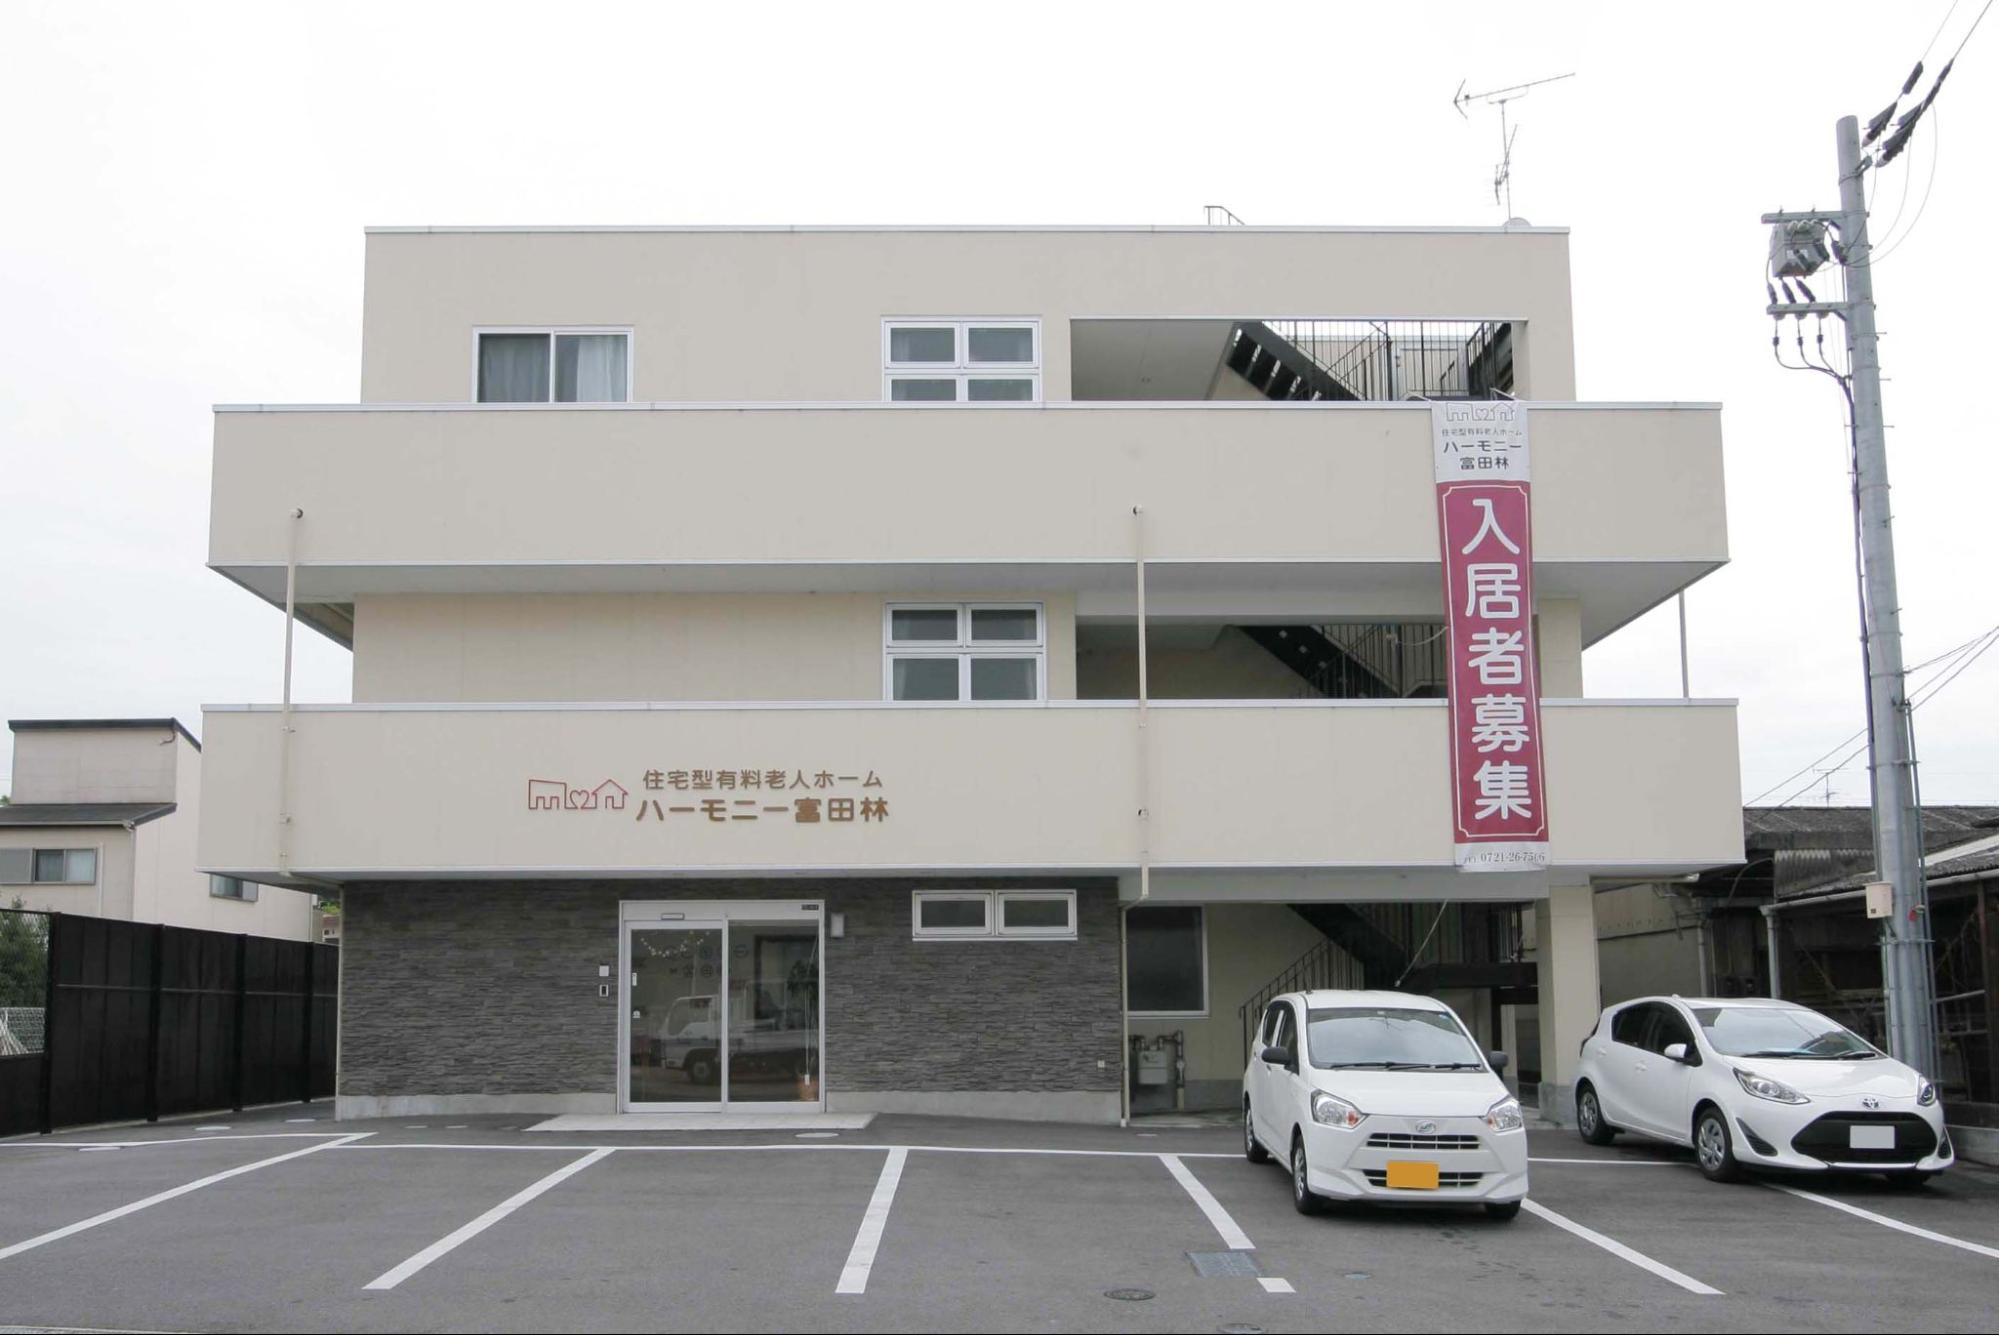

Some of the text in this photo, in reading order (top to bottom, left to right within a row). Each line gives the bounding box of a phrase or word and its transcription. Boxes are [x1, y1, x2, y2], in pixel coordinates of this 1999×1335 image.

[1443, 440, 1522, 454] ハーモニー
[1460, 456, 1509, 470] 富田林
[1462, 499, 1532, 820] 入居者募集
[643, 769, 884, 790] 住宅型有料老人ホーム
[636, 797, 889, 823] ハーモニー富田林
